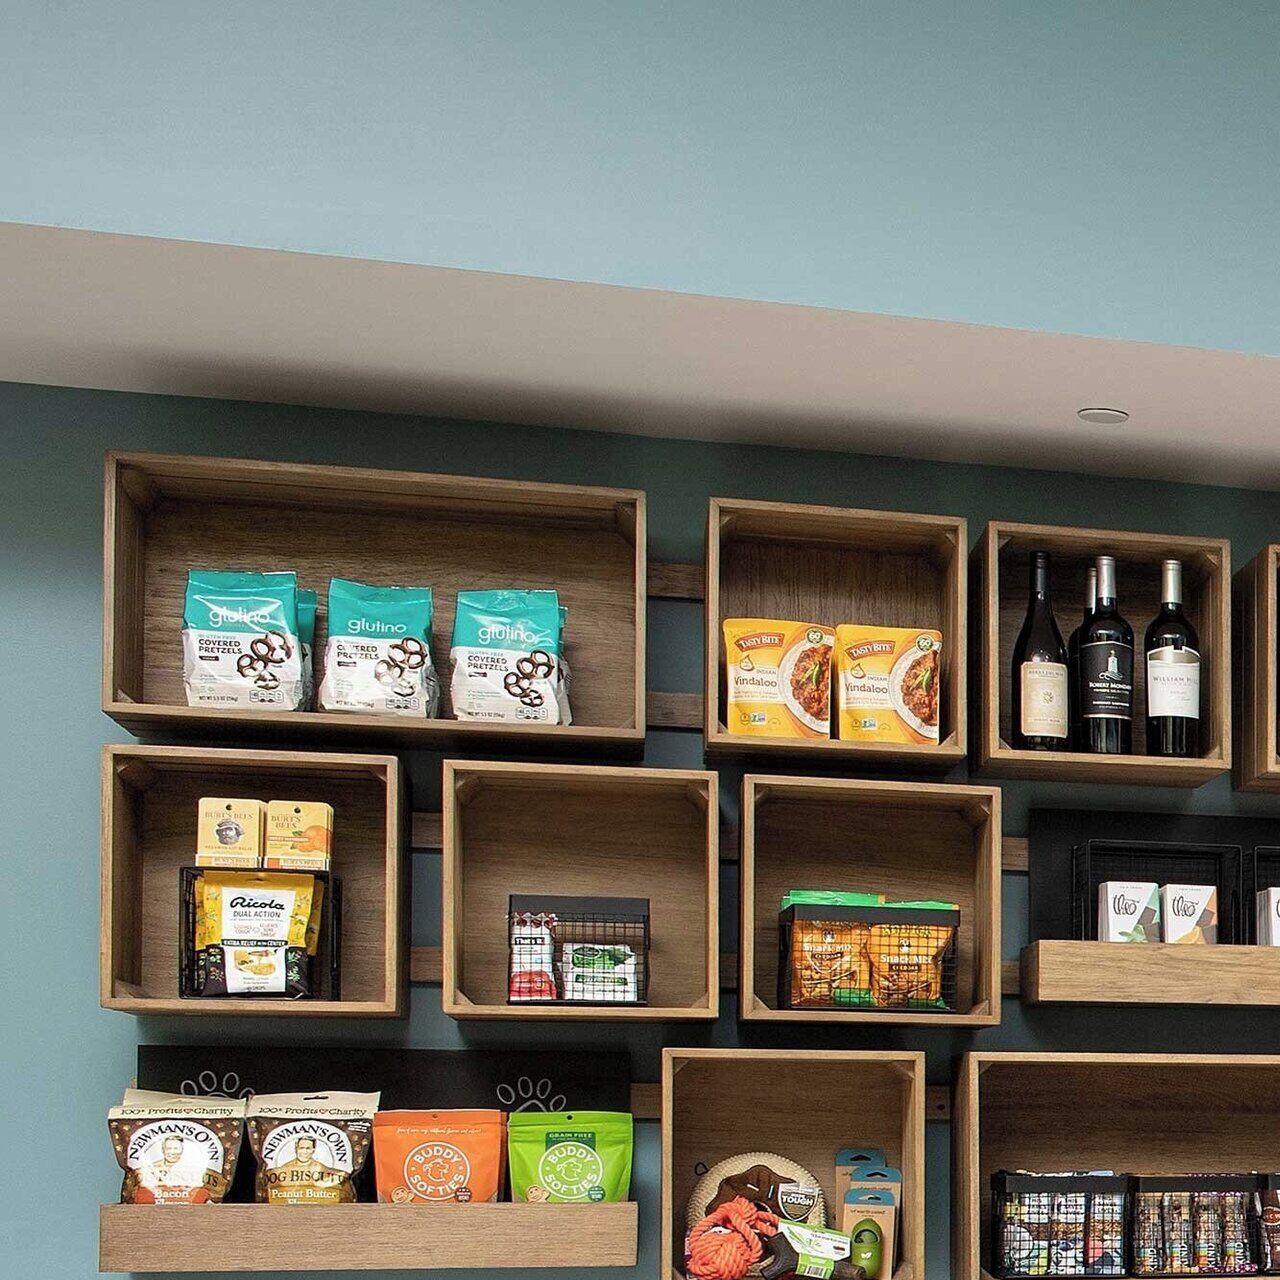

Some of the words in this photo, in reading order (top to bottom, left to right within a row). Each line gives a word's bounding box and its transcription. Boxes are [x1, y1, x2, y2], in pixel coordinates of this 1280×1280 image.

[347, 618, 407, 634] glutino
[478, 625, 535, 645] glutino
[738, 635, 762, 650] TASTY
[762, 633, 781, 645] BITE
[198, 638, 240, 648] COVERED
[850, 644, 873, 658] TASTY
[873, 641, 893, 653] BITE
[198, 646, 243, 655] PRETZELS
[467, 655, 508, 664] COVERED
[467, 662, 509, 672] PRETZELS
[733, 676, 778, 688] Vindaloo
[845, 682, 889, 694] Vindaloo
[229, 896, 285, 910] Ricola
[233, 910, 252, 918] DUAL
[253, 910, 281, 919] ACTION
[148, 1106, 183, 1116] Profits
[194, 1107, 234, 1117] Charity
[285, 1106, 319, 1116] Profits
[328, 1107, 367, 1118] Charity
[129, 1121, 195, 1161] NEWMAN'S
[263, 1121, 328, 1161] NEWMAN'S
[413, 1146, 462, 1164] BUDDY
[548, 1146, 594, 1164] BUDDY
[409, 1172, 465, 1195] SOFTIES
[544, 1171, 598, 1194] SOFTIES
[154, 1189, 189, 1199] Bacon
[271, 1189, 304, 1199] Peanut
[306, 1189, 337, 1199] Butter
[781, 1194, 814, 1207] TOUGH
